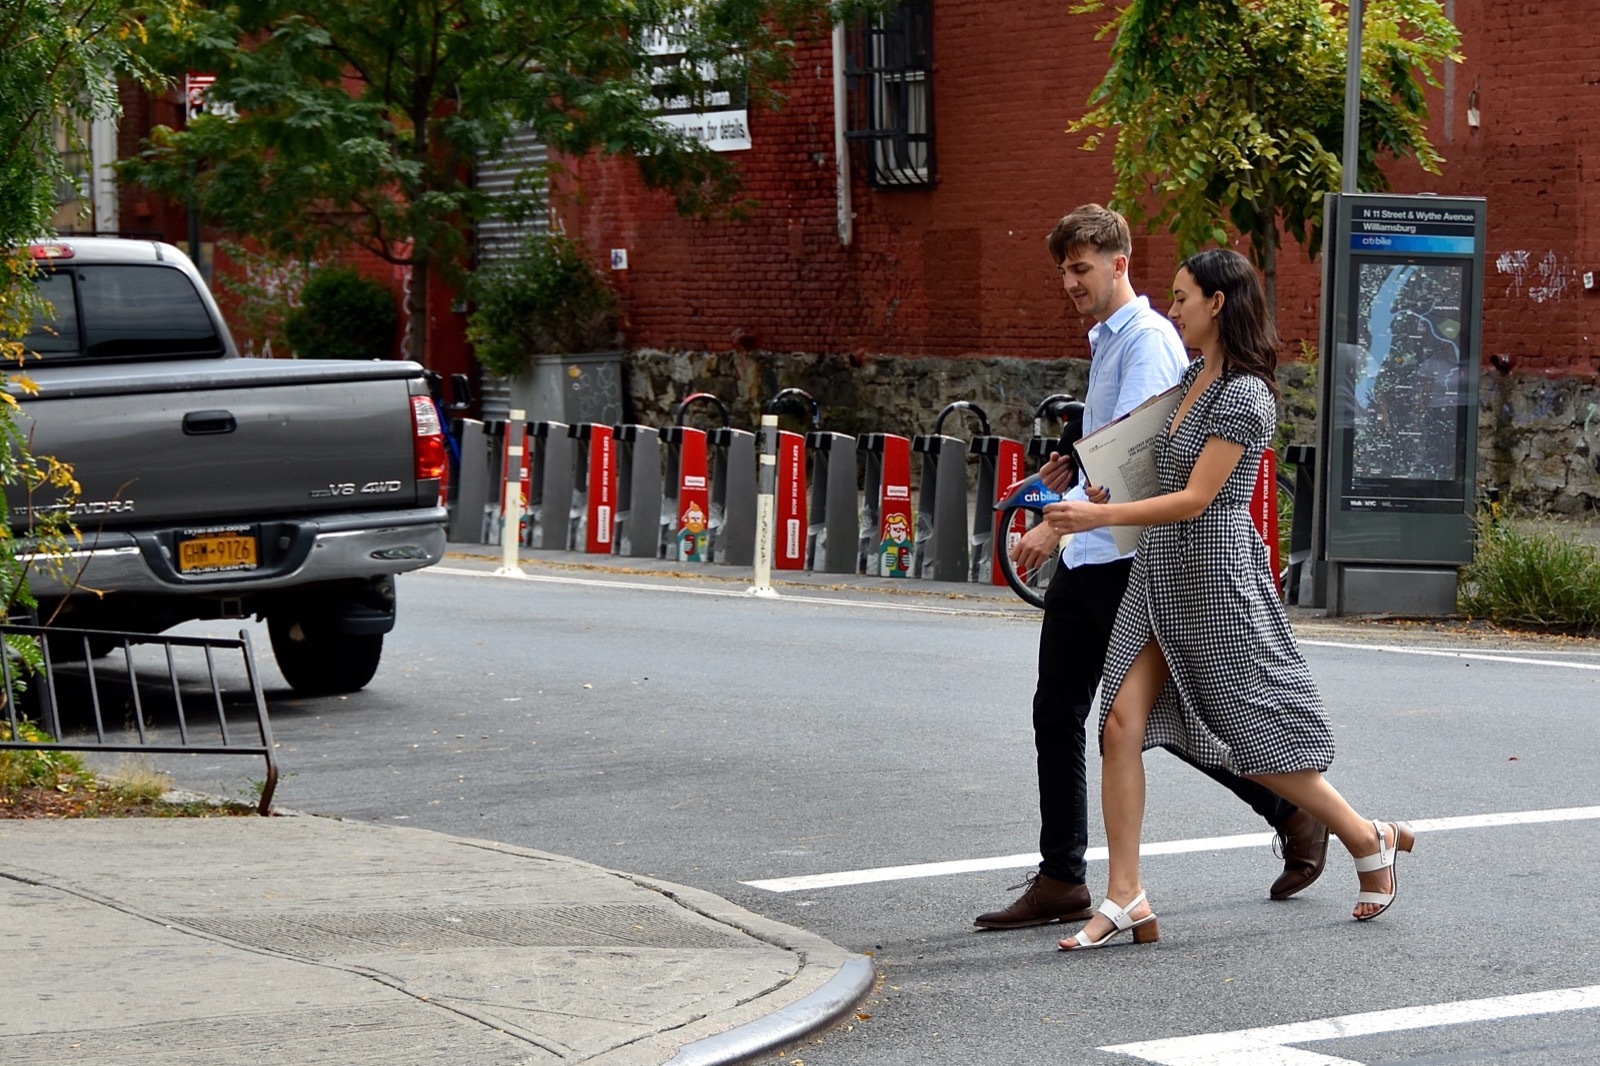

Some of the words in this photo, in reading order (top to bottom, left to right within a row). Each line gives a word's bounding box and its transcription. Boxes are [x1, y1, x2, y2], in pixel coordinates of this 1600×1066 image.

[1363, 209, 1371, 218] N
[1372, 209, 1380, 218] 11
[1381, 209, 1406, 219] Street
[1407, 210, 1414, 219] &
[1415, 211, 1441, 222] Wythe
[1443, 212, 1474, 222] Avenue
[1363, 222, 1416, 234] Williamsburg
[360, 480, 402, 493] 4WD
